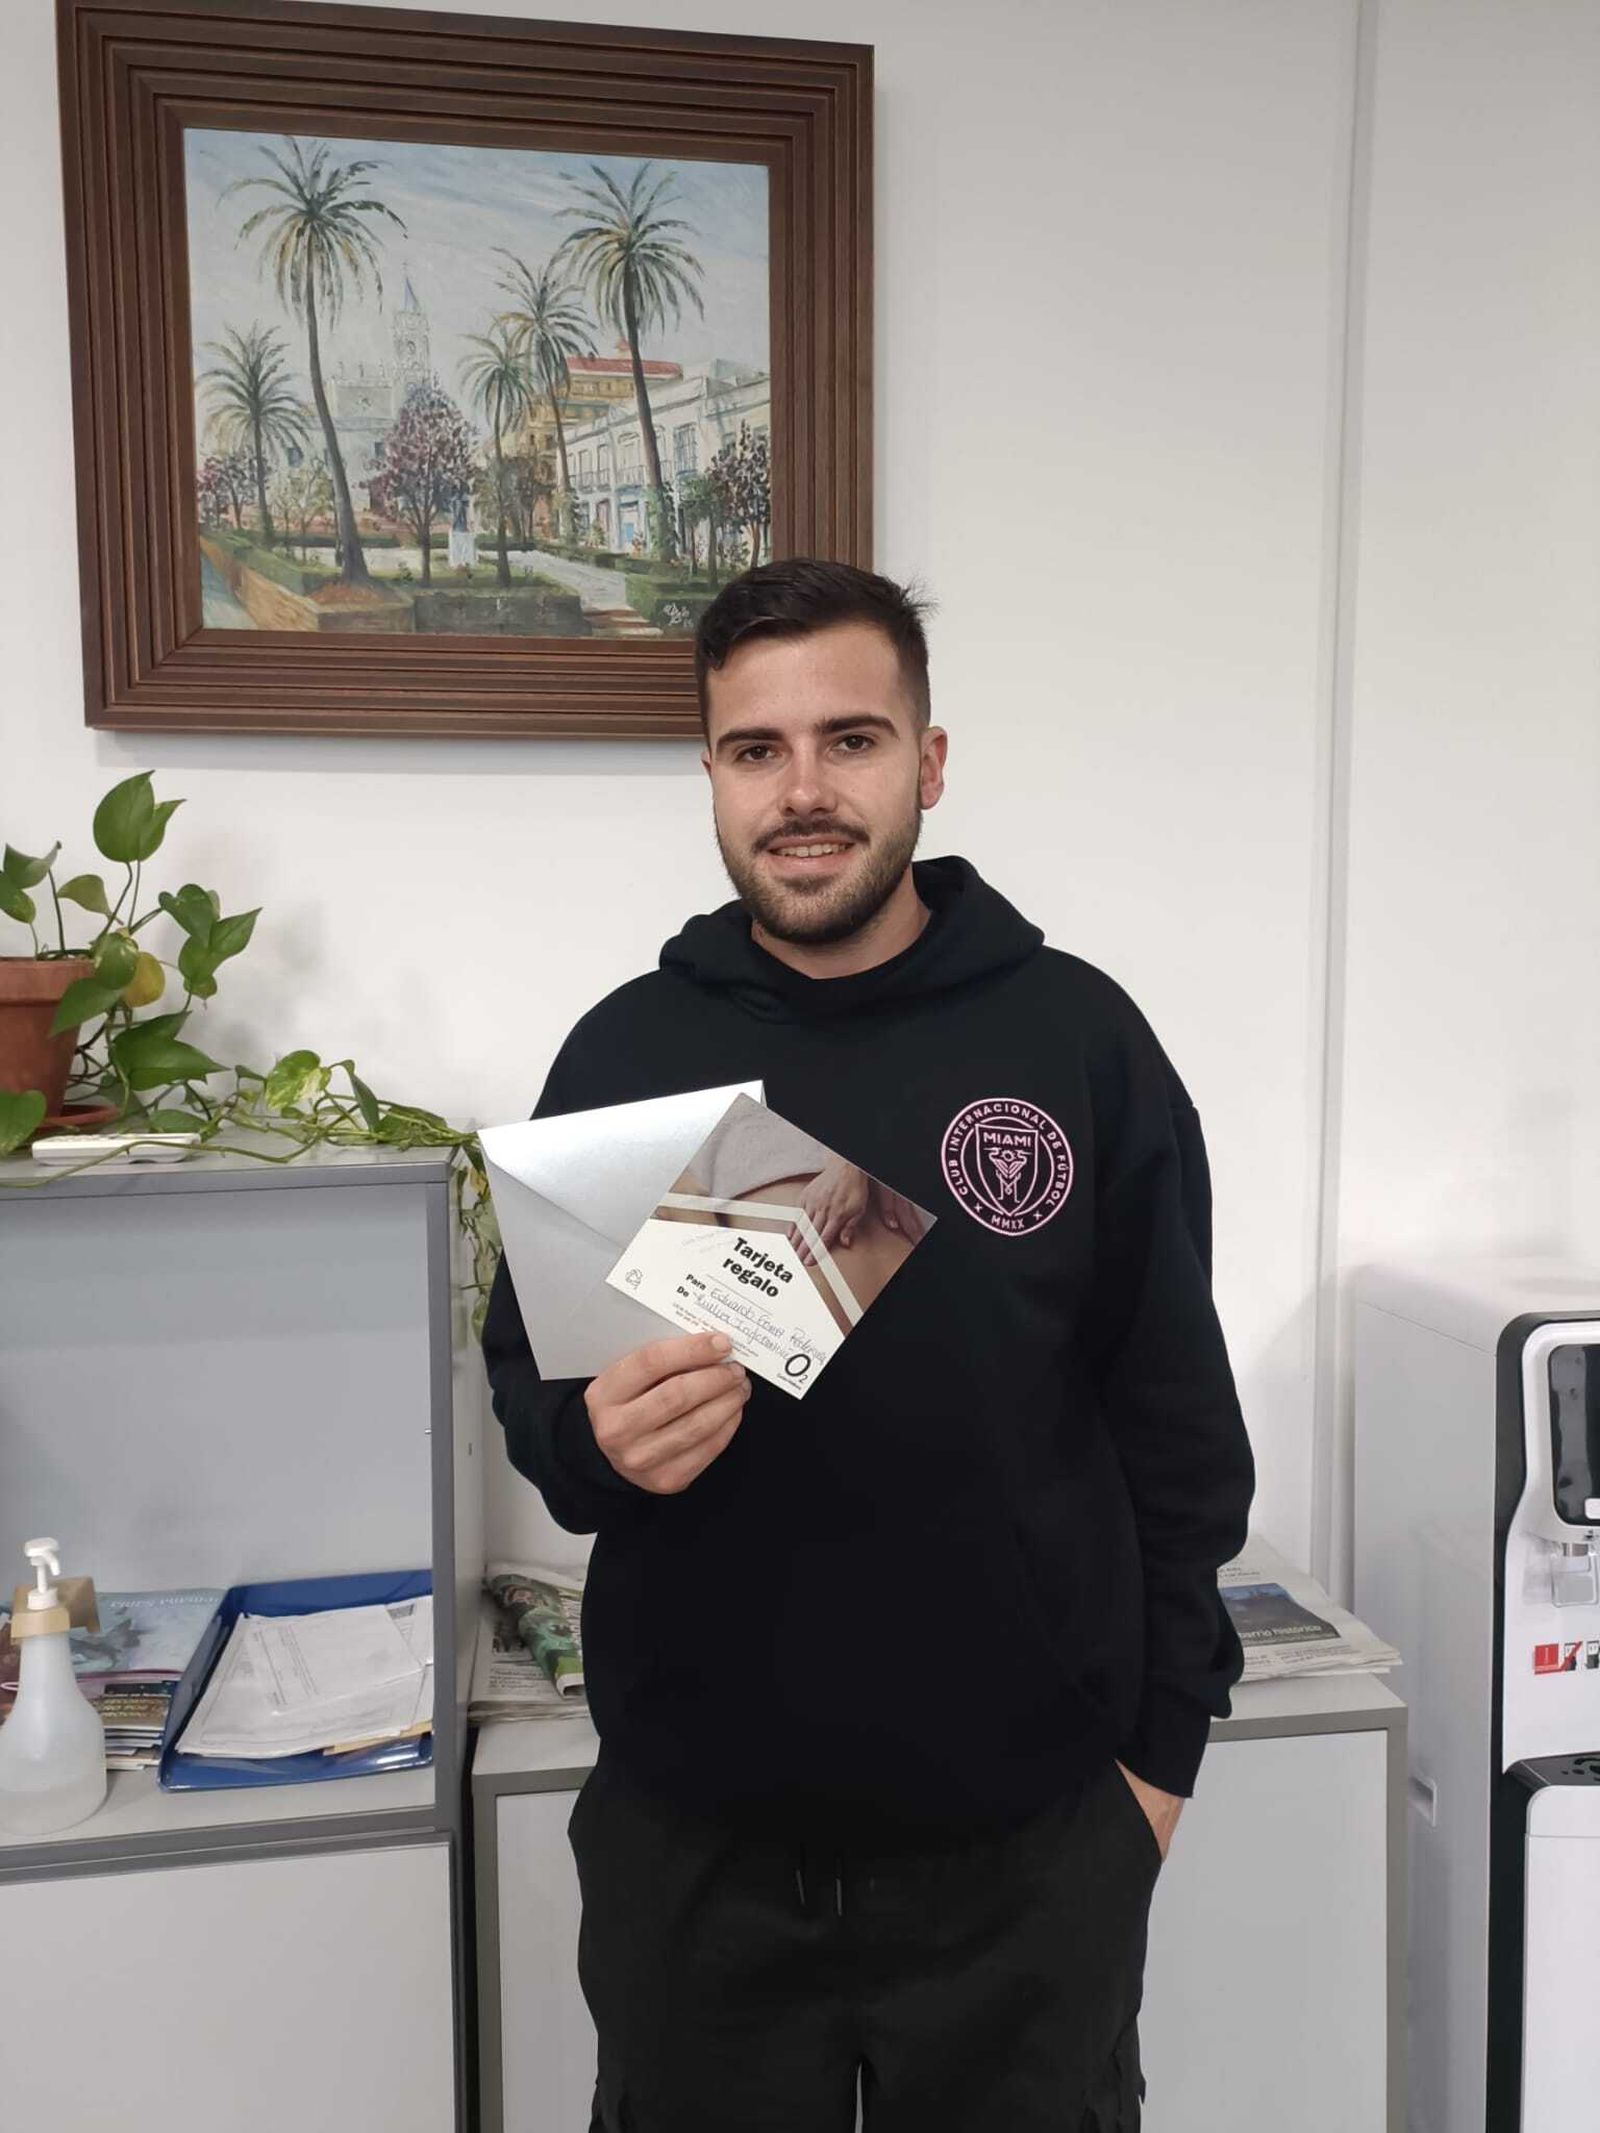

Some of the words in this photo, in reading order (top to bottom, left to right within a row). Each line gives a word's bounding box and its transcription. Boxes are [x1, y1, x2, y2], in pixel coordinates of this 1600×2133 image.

[948, 1103, 1046, 1152] INTERNACIONAL
[983, 1131, 1032, 1147] MIAMI
[1046, 1131, 1061, 1150] DE
[948, 1159, 969, 1196] CLUB
[991, 1214, 1025, 1230] MMIX
[732, 1236, 794, 1284] Tarjeta
[685, 1273, 706, 1290] Para
[722, 1256, 780, 1298] regalo
[676, 1285, 690, 1298] De
